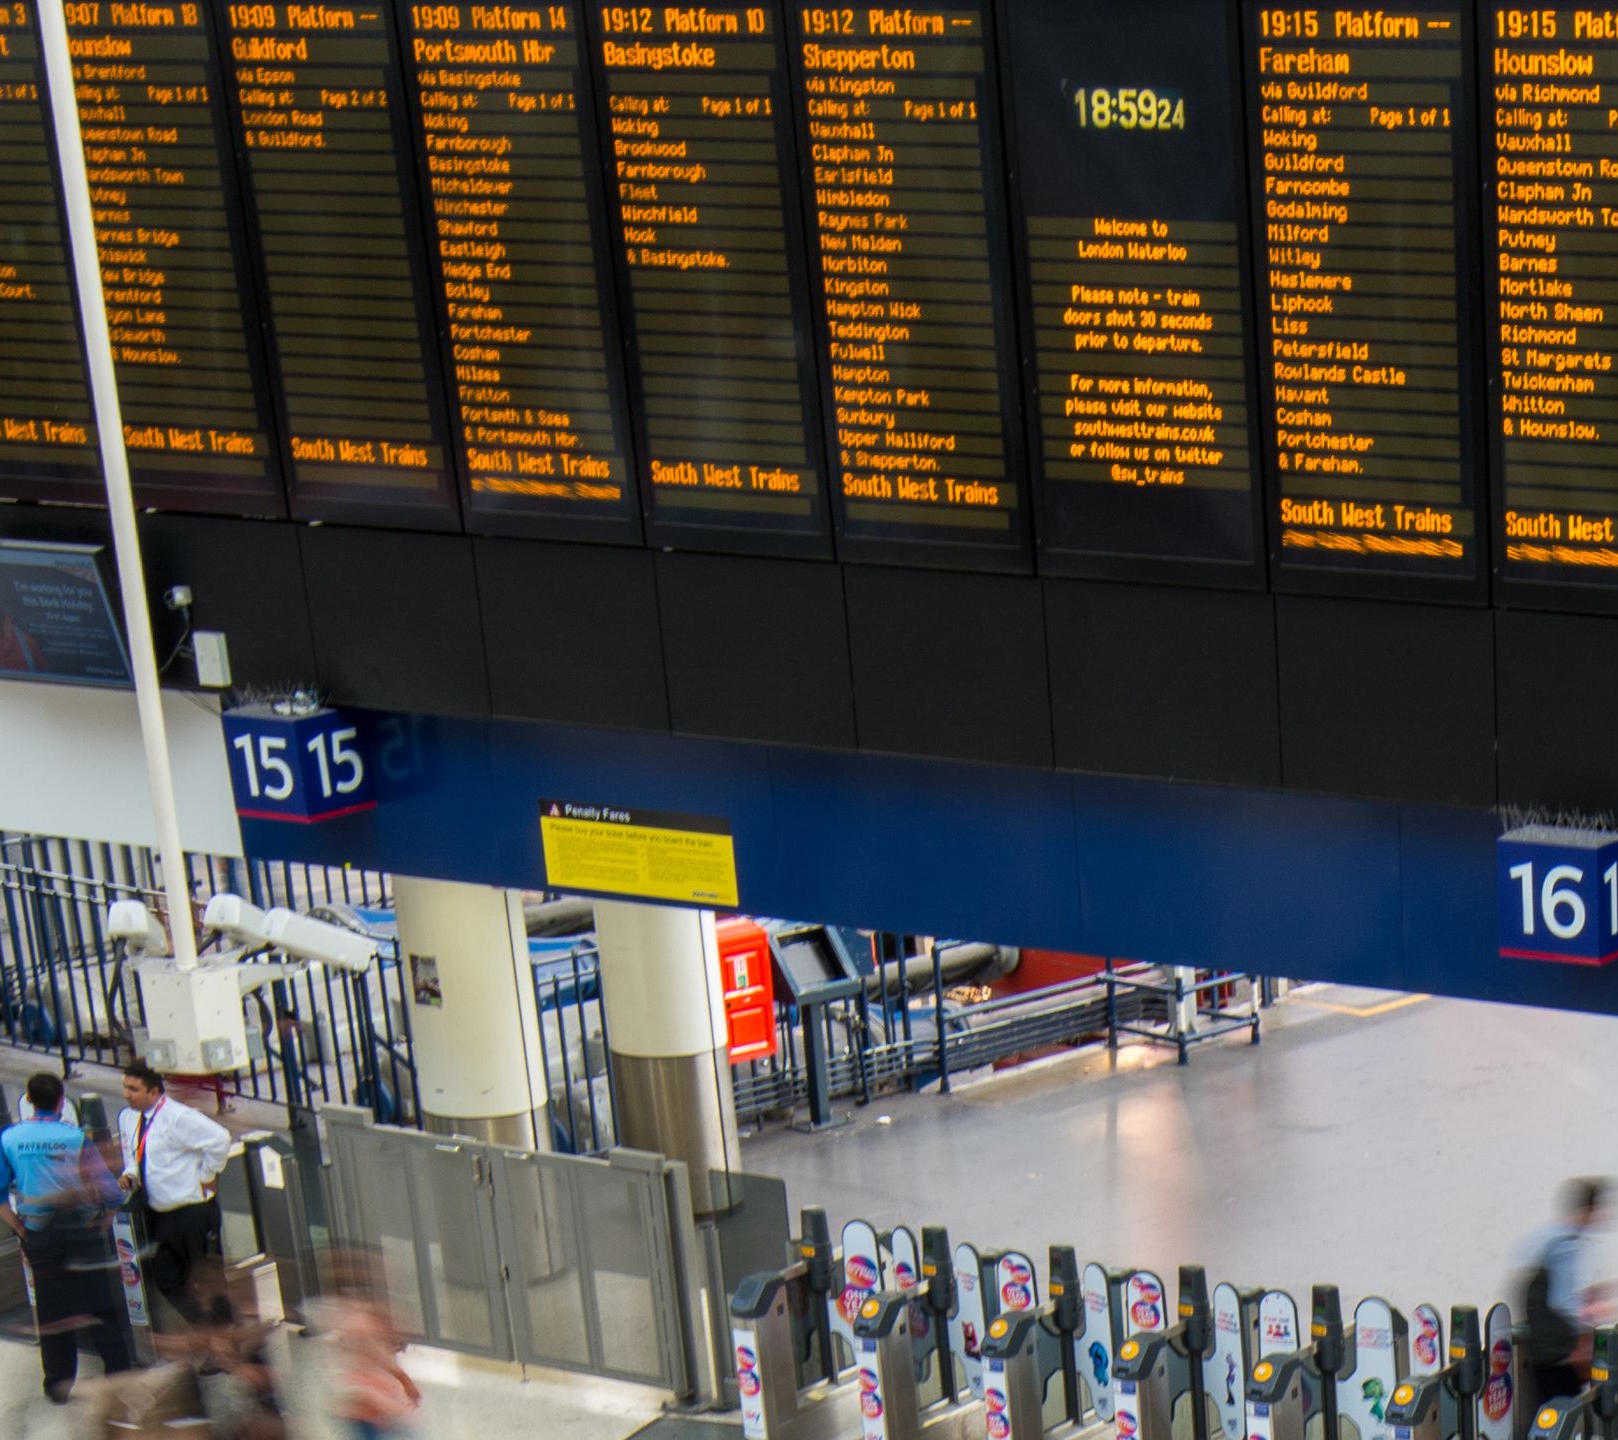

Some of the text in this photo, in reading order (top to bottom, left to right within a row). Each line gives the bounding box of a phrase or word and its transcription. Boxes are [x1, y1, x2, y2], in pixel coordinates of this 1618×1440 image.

[13, 2, 28, 26] 3
[602, 6, 767, 34] 19:12 Platform 10
[603, 40, 718, 71] Basingstoke
[802, 42, 917, 73] Shepperton
[1261, 47, 1351, 74] Fareham
[650, 459, 802, 493] South West Trains
[233, 734, 294, 799] 15
[308, 730, 363, 797] 15
[565, 803, 631, 823] Penalty Fares
[1509, 861, 1587, 939] 16
[18, 1142, 67, 1152] WATERLOO
